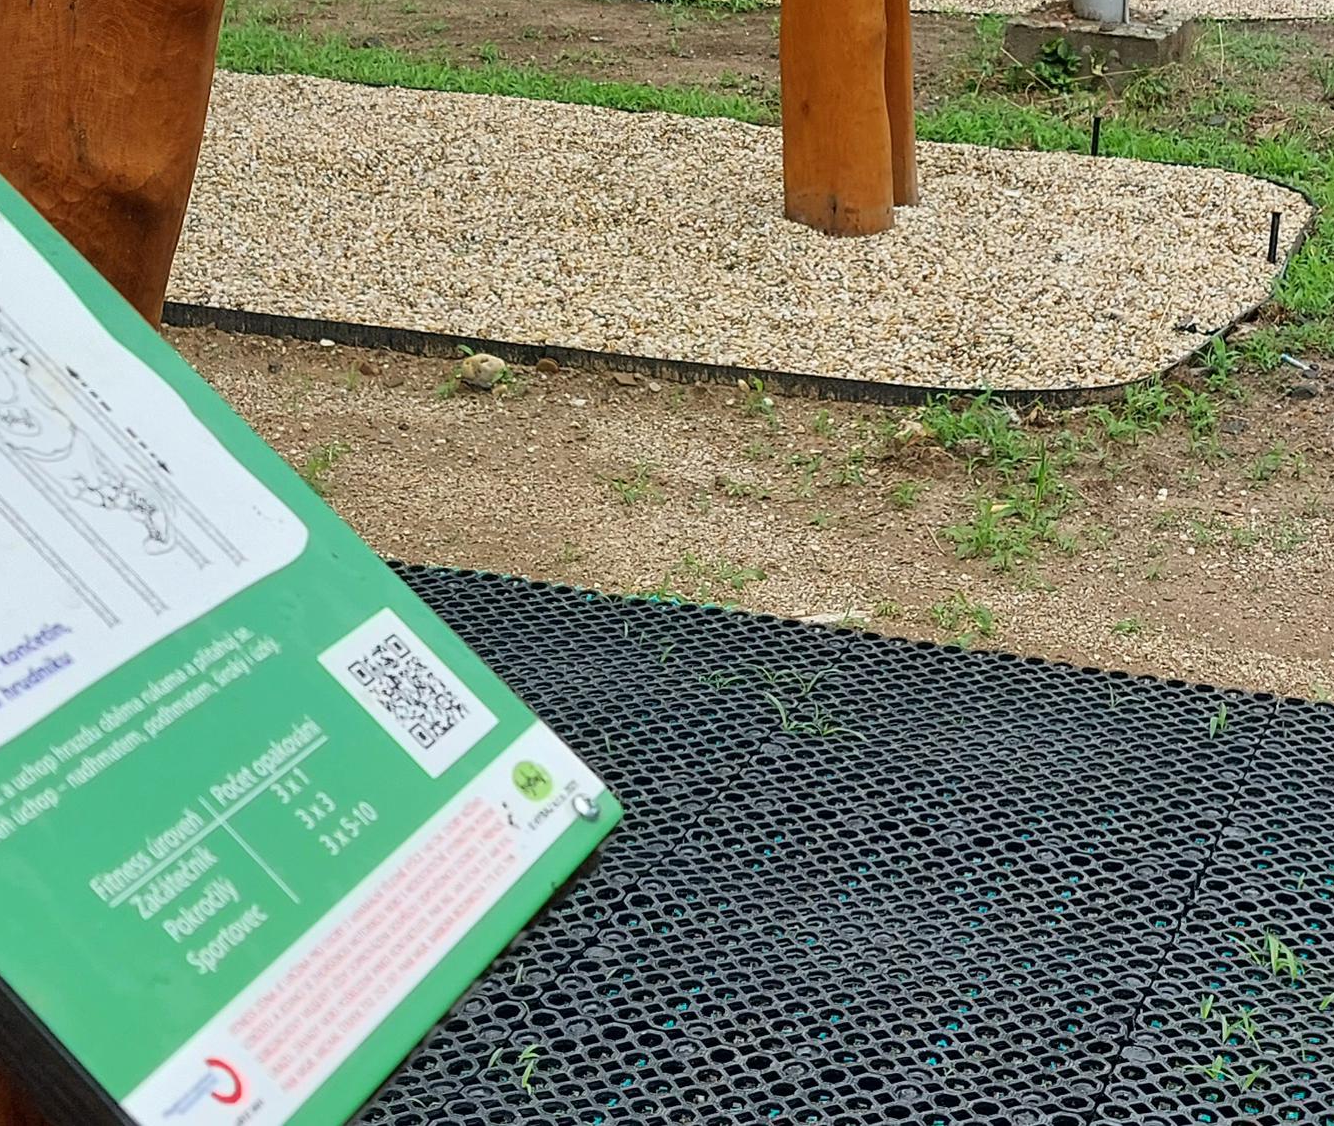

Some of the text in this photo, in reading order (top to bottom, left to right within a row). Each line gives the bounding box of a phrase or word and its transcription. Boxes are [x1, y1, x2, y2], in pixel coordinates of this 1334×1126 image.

[0, 782, 16, 798] a
[49, 724, 106, 764] hrazdu
[88, 849, 153, 902] Fitness
[145, 806, 204, 861] úroveň
[209, 765, 259, 807] Počet
[129, 767, 311, 921] Začátečník 3 x 1
[162, 790, 336, 944] Pokročilý 3 x 3
[185, 800, 379, 975] Sportovec 3 x 5-10
